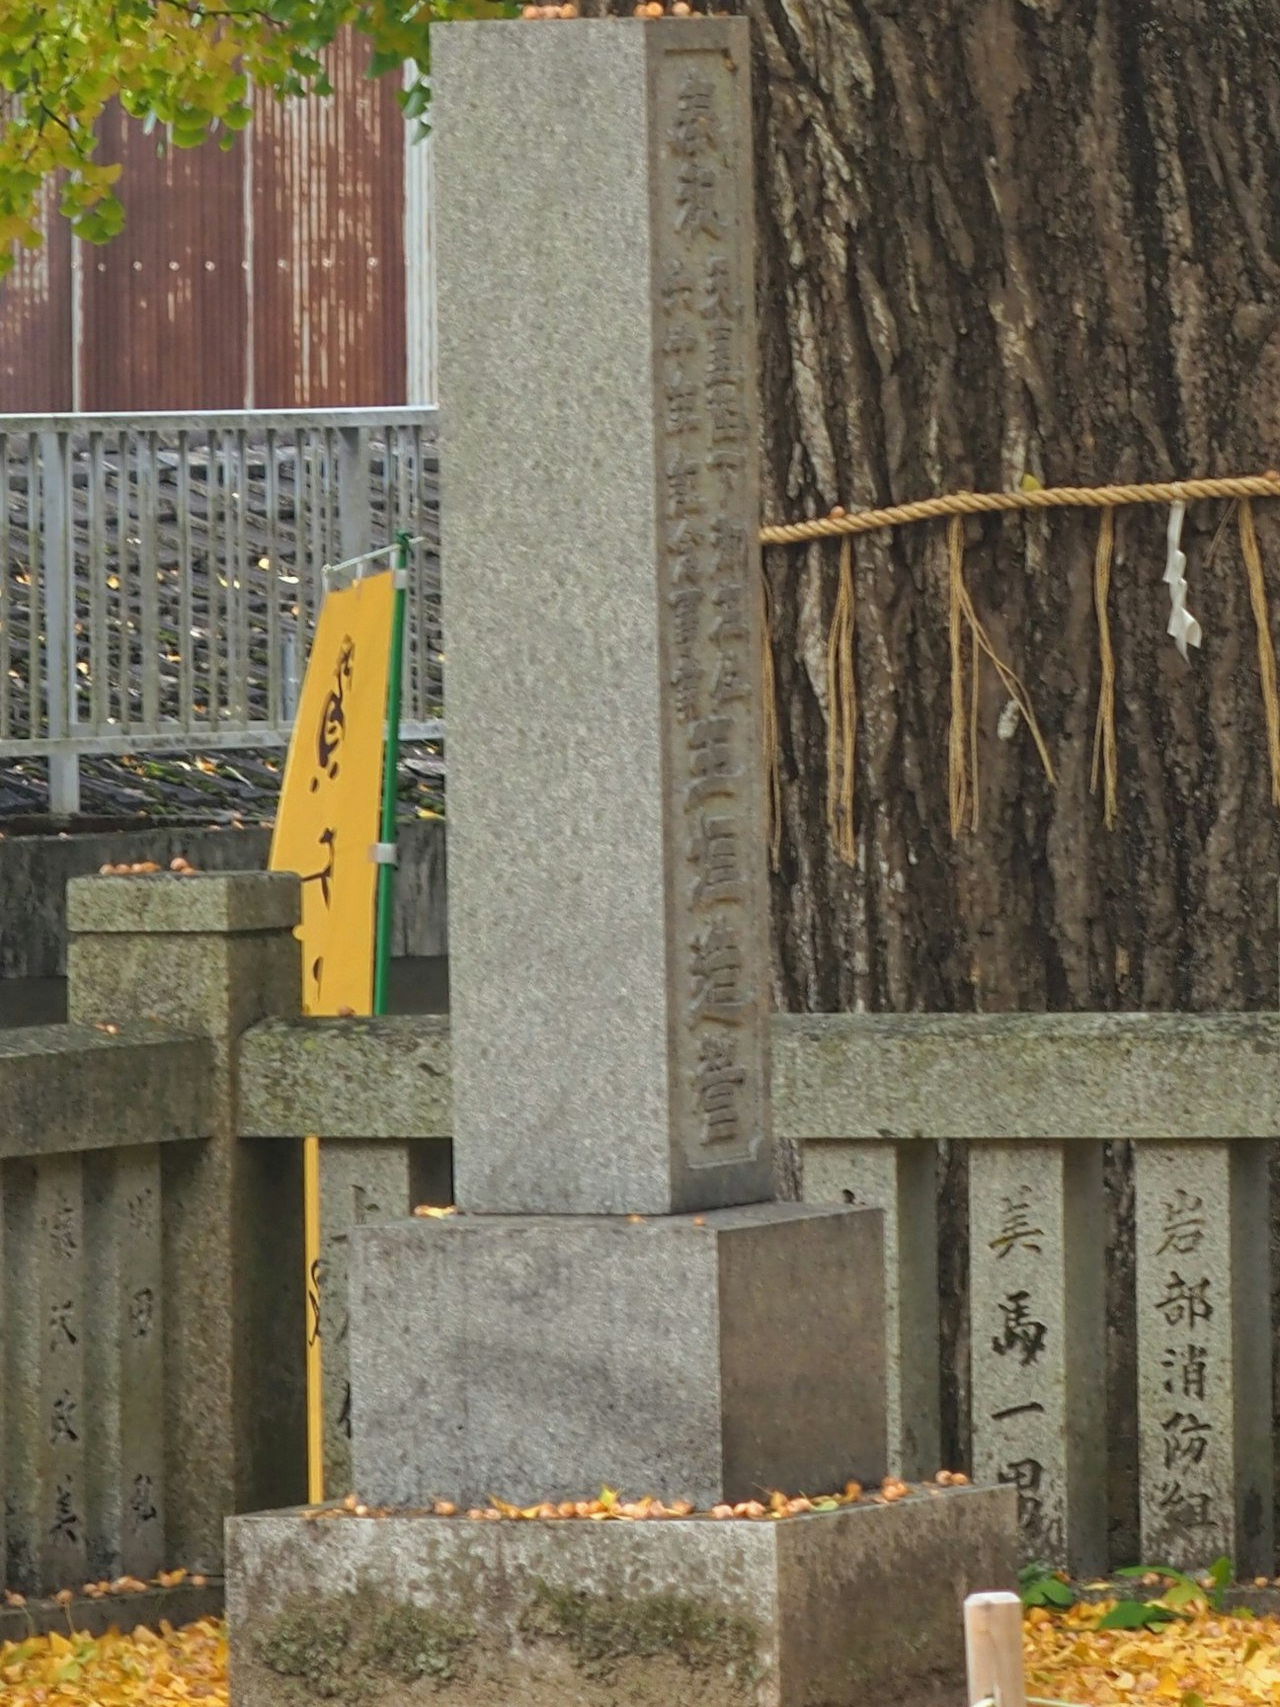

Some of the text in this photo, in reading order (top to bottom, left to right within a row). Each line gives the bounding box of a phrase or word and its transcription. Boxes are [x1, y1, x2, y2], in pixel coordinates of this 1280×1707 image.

[988, 1184, 1050, 1545] 美馬一男
[1153, 1188, 1217, 1530] 岩部消防組
